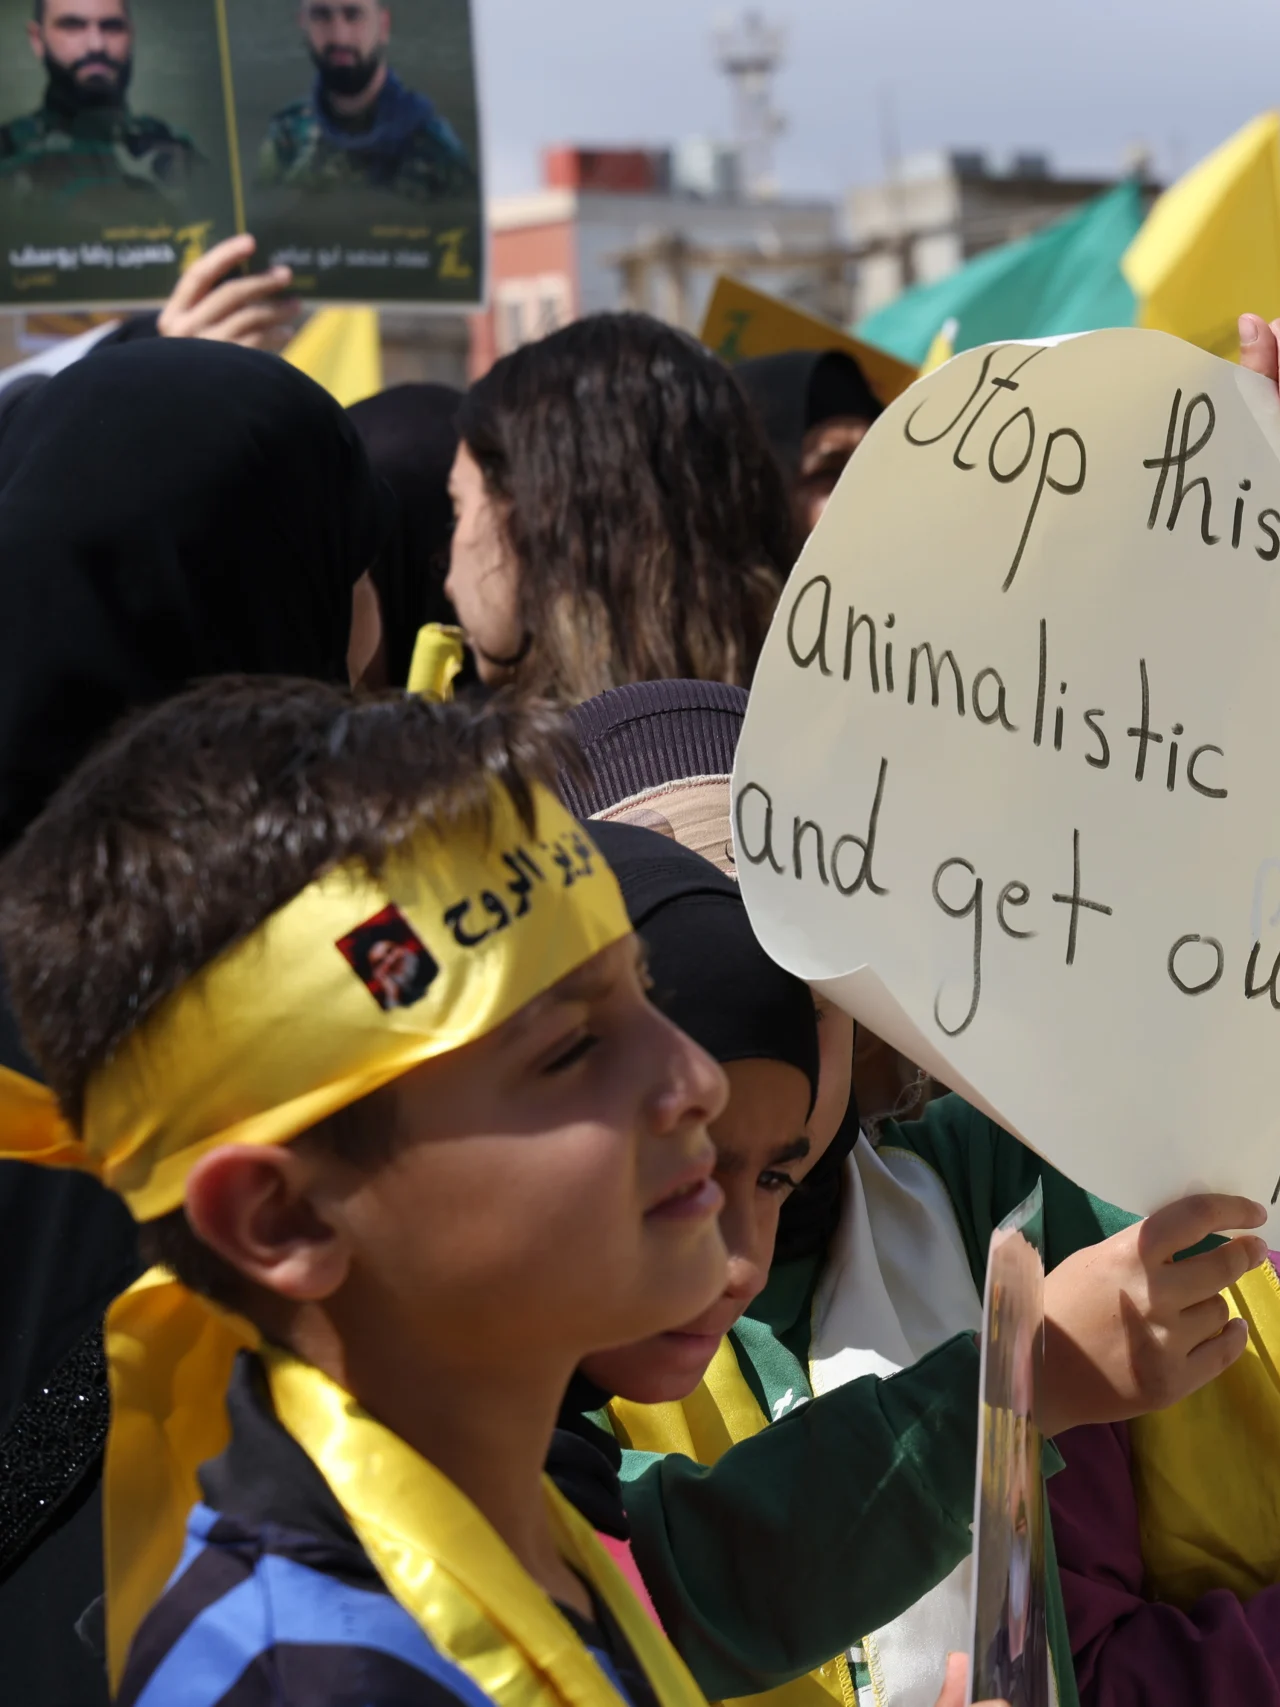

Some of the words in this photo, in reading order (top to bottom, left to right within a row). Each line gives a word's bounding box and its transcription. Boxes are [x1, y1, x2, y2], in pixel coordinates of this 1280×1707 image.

[903, 343, 1087, 594] Stop
[786, 574, 1229, 800] animalistic
[443, 846, 546, 948] الروح
[735, 756, 891, 897] and
[931, 826, 1114, 1038] get
